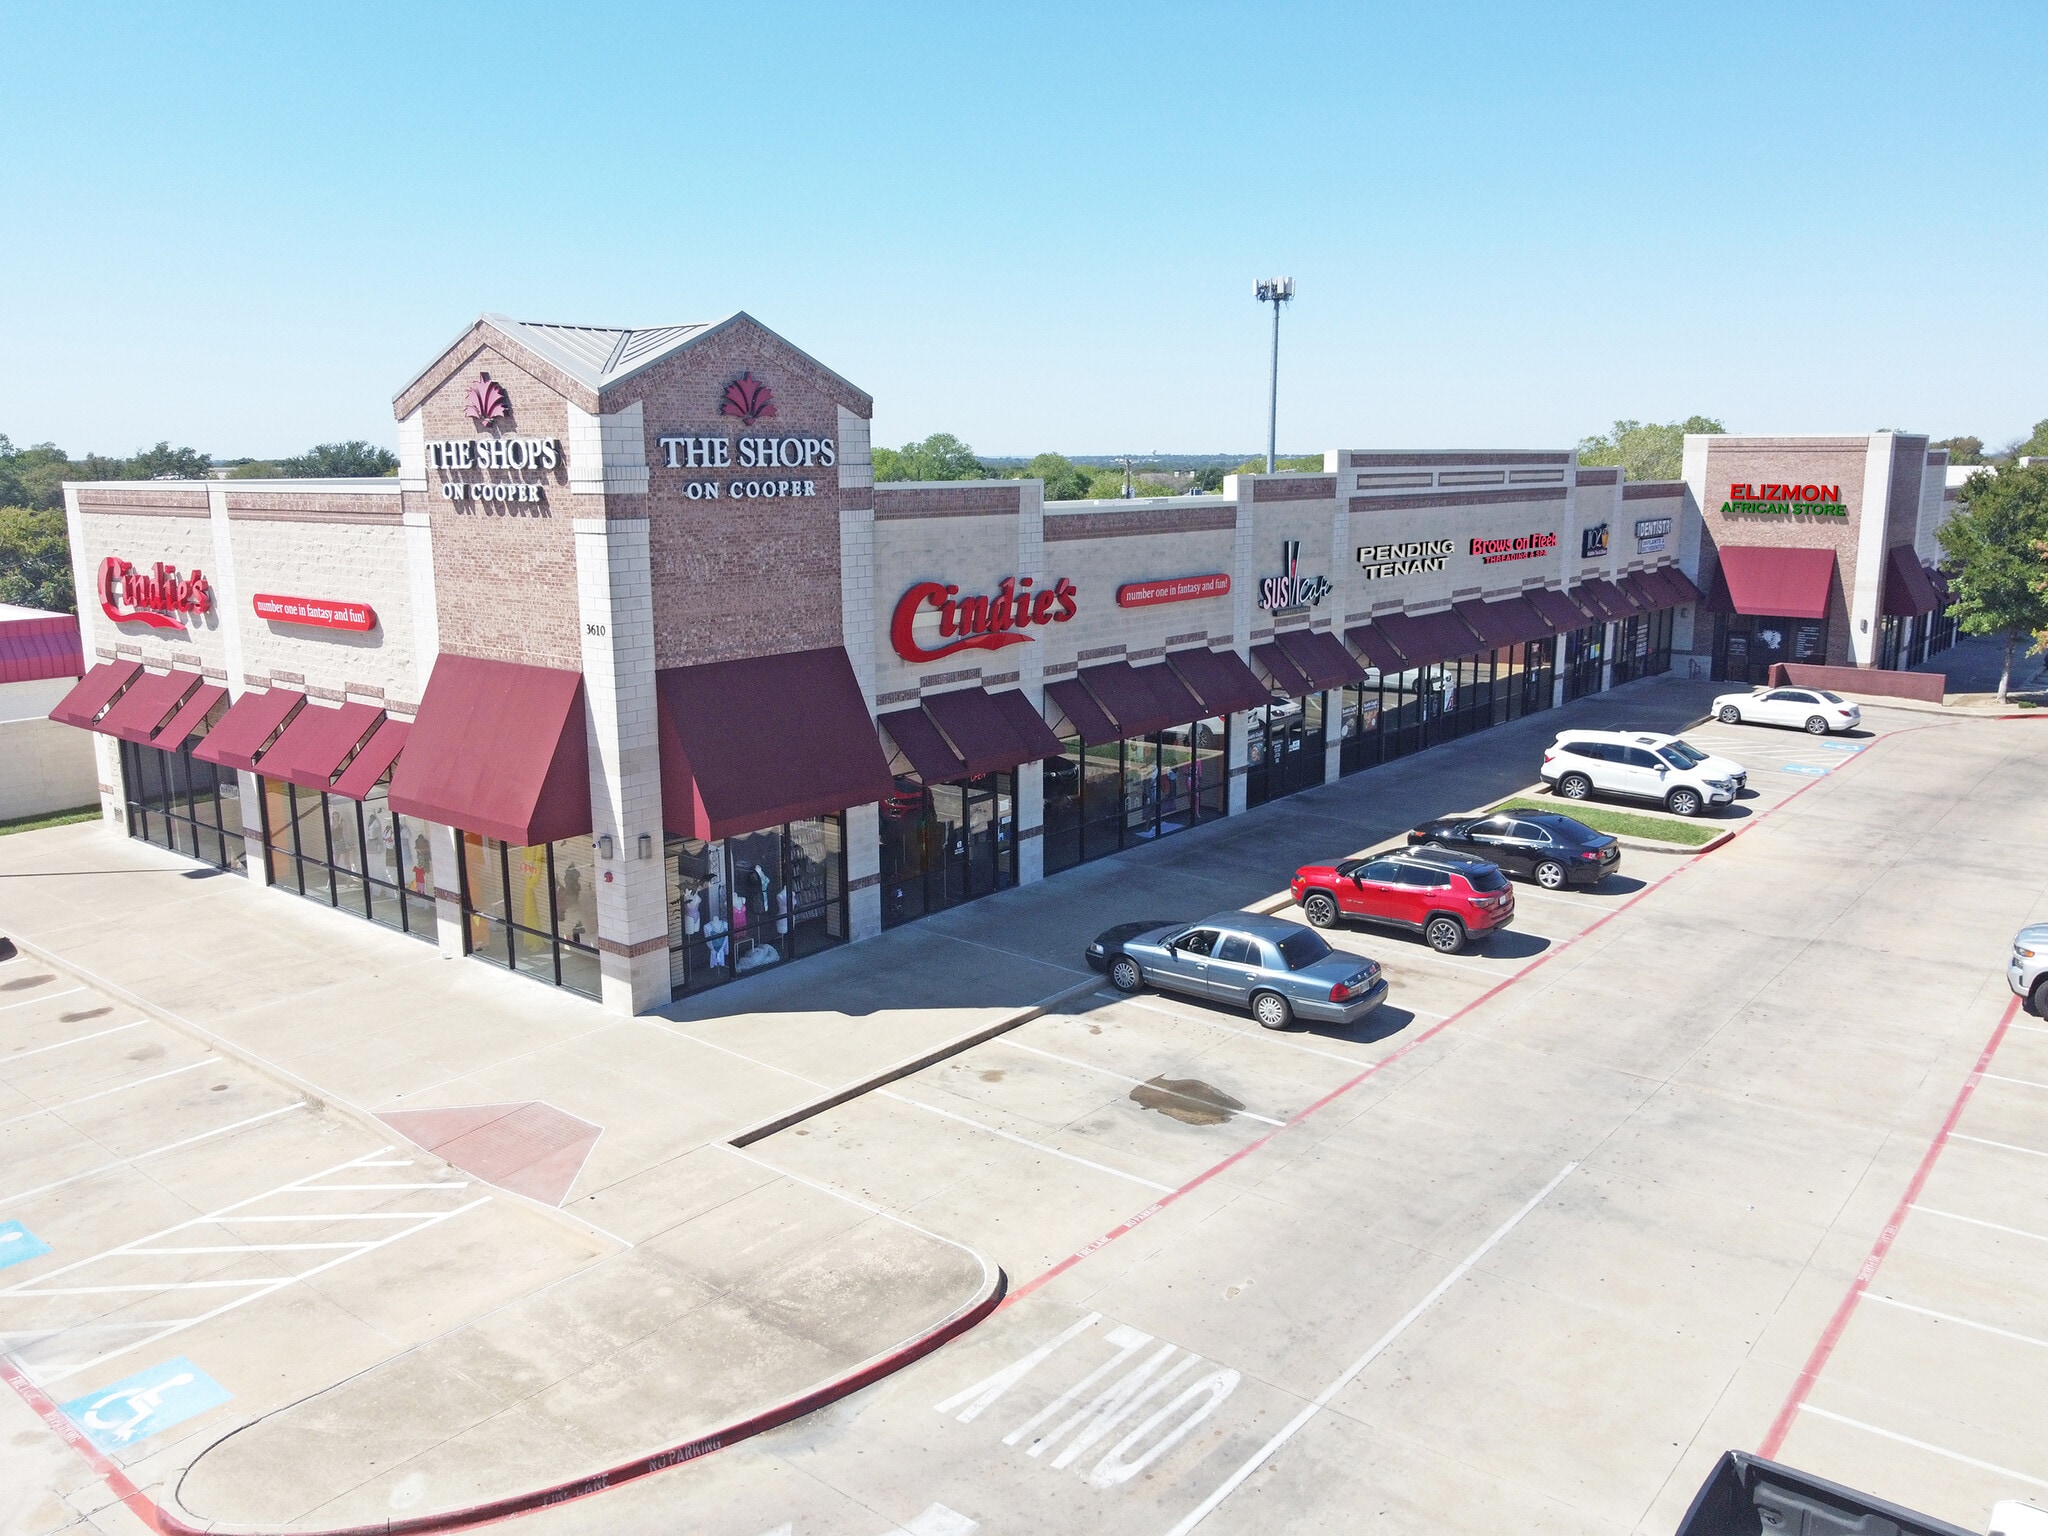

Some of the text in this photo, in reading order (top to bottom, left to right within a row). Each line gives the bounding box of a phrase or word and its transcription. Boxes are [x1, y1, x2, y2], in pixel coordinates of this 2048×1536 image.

[426, 438, 557, 470] THE SHOPS
[660, 437, 835, 468] THE SHOPS
[442, 484, 540, 502] ON COOPER
[687, 480, 816, 500] ON COOPER
[1730, 483, 1839, 501] ELIZMON
[1720, 501, 1847, 517] AFRICAN STORE
[1360, 540, 1454, 562] PENDING
[1472, 532, 1557, 555] Brows on Fleek
[1366, 557, 1449, 580] TENANT
[1485, 552, 1528, 564] THREADING
[98, 556, 210, 630] Cindie's
[1126, 578, 1228, 601] number one in fantasy and fun!
[257, 601, 365, 623] number one in fantasy and fun!
[891, 577, 1077, 663] Cindie's
[586, 623, 606, 636] 3610
[934, 1312, 1241, 1488] ONLY
[650, 1436, 721, 1472] NO PARKING
